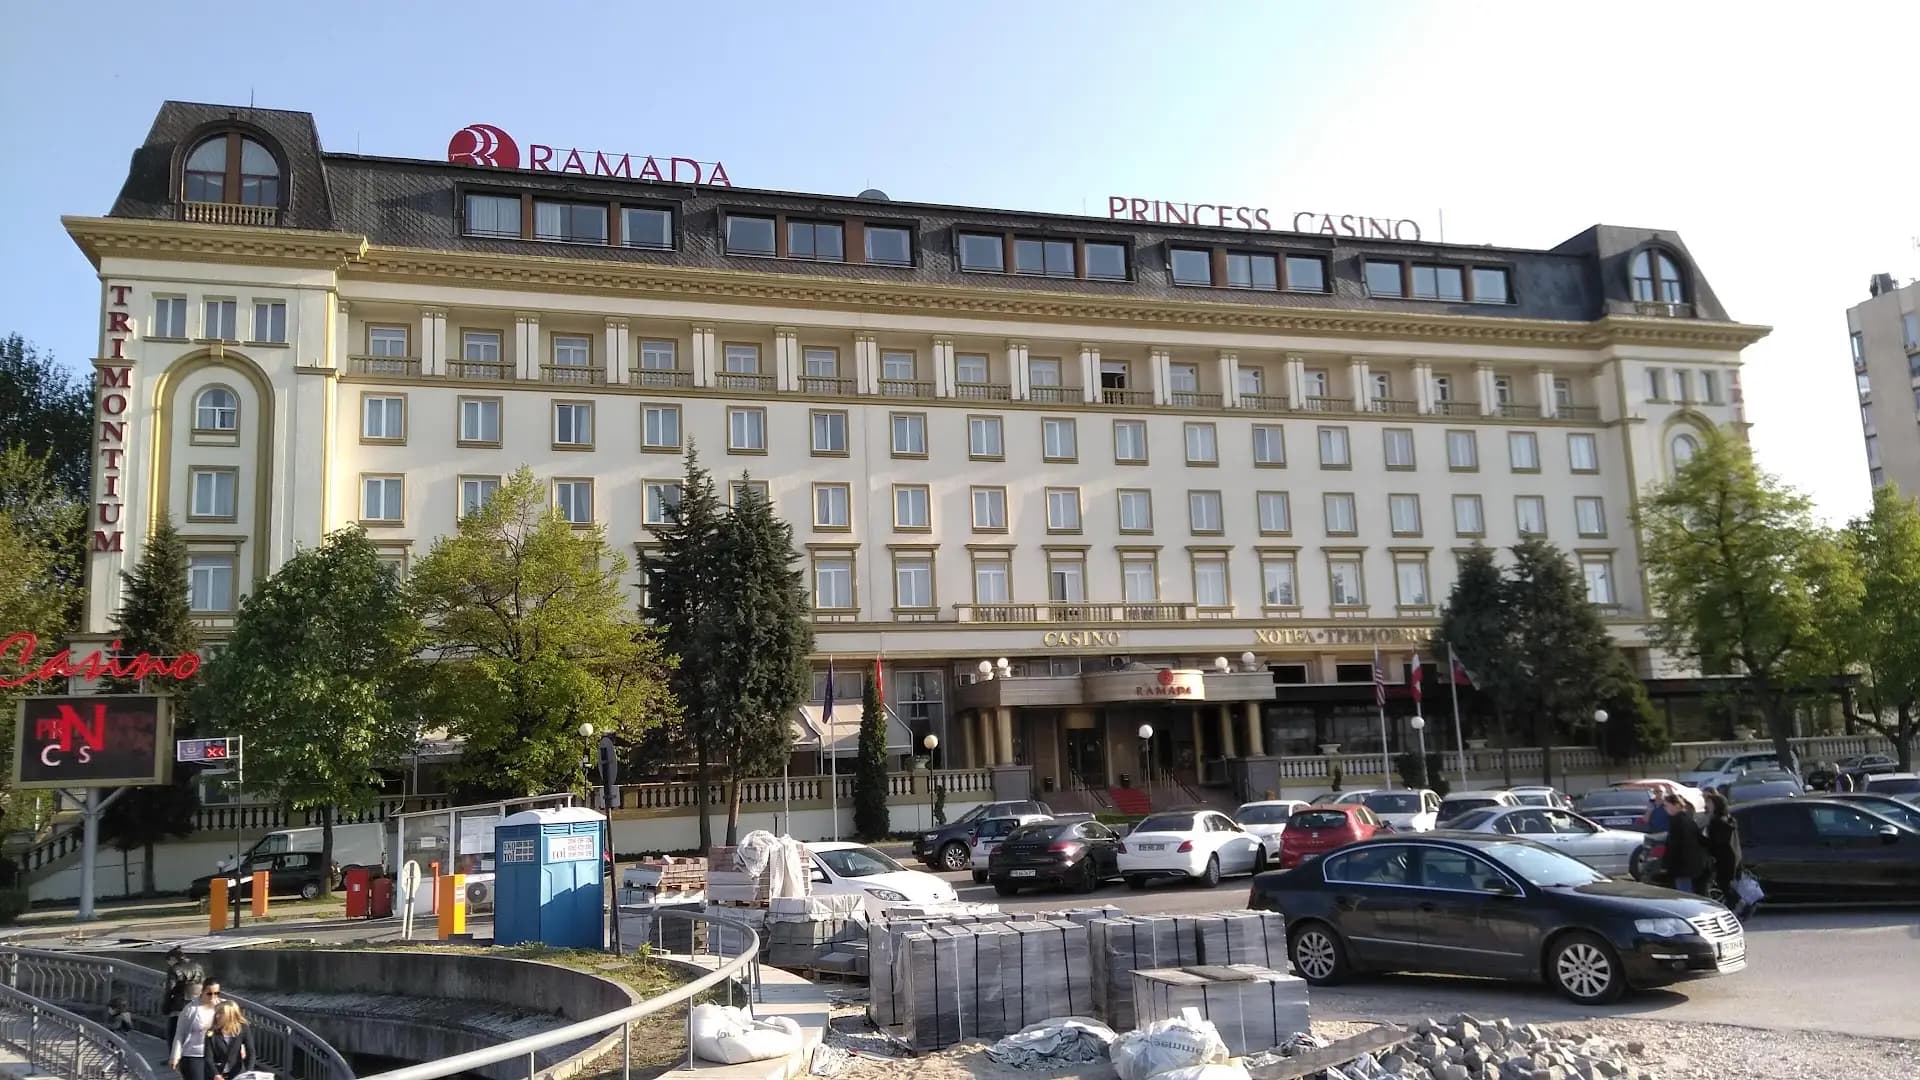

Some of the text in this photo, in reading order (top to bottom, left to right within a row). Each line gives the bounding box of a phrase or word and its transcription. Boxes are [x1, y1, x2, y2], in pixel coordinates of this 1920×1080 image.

[529, 144, 733, 187] RAMADA
[1108, 195, 1421, 241] PRINCESS CASINO
[92, 284, 133, 552] TRIMONTIUM
[1043, 630, 1121, 647] CASINO
[1255, 628, 1316, 644] ХОТЕЛ
[0, 630, 201, 688] Casino
[1135, 686, 1192, 697] RAMADA
